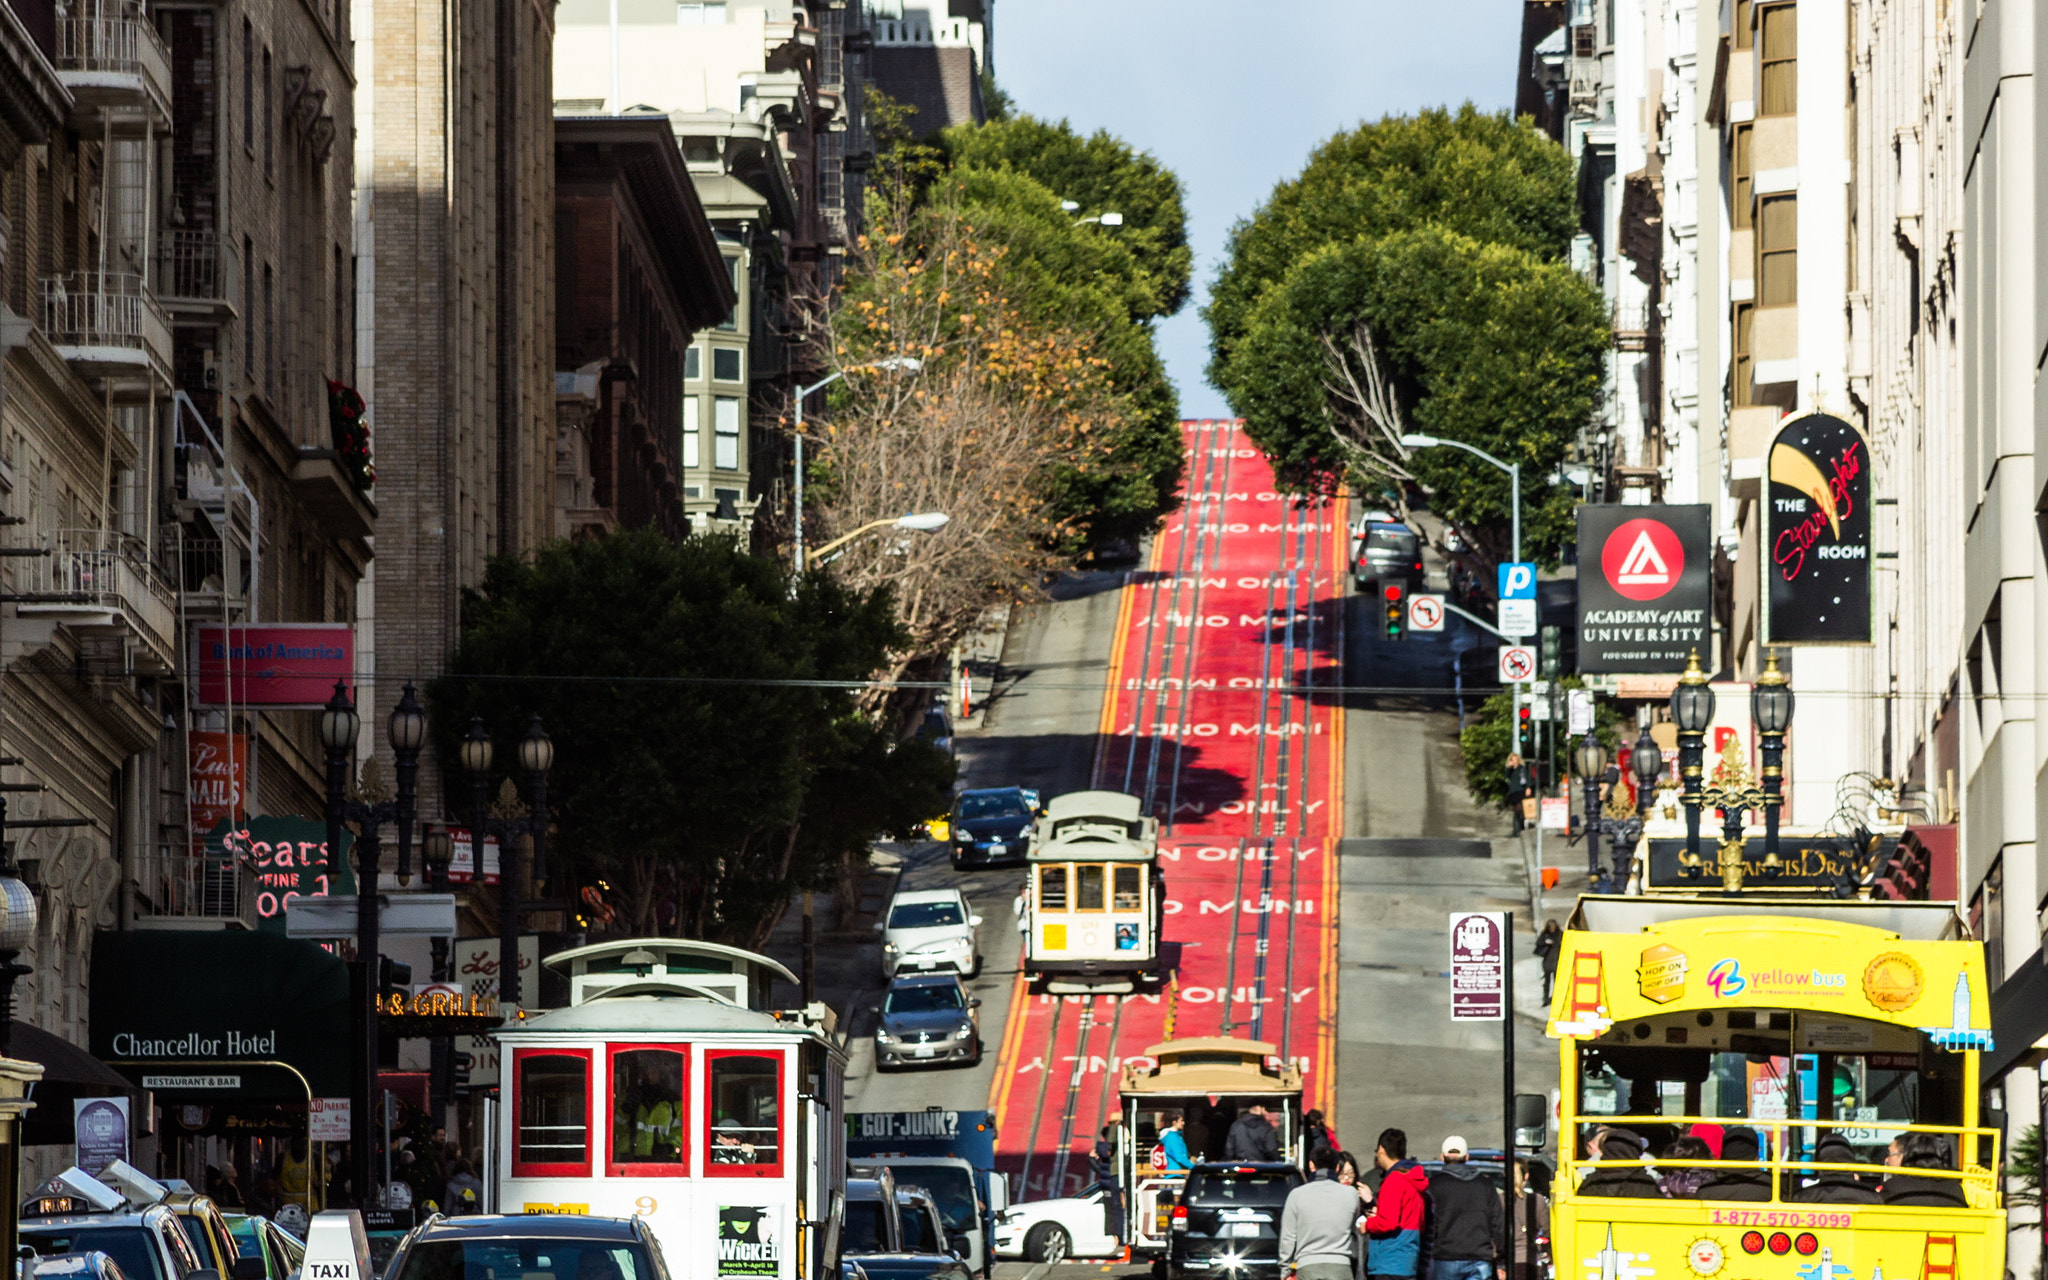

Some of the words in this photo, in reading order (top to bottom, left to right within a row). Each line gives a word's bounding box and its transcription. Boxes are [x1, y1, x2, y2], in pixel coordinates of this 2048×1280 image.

[1775, 499, 1806, 512] THE
[1818, 546, 1866, 559] ROOM
[1584, 609, 1659, 624] ACADEMY
[1659, 610, 1674, 626] of
[1672, 609, 1704, 623] ART
[1584, 627, 1704, 642] UNIVERSITY
[257, 643, 274, 659] of
[276, 643, 343, 659] America
[186, 779, 240, 806] NAILS
[1220, 800, 1324, 814] ONLY
[1197, 847, 1317, 861] ONLY
[1200, 900, 1313, 914] MUNI
[1645, 966, 1666, 976] HOP
[1668, 962, 1681, 971] ON
[1750, 970, 1809, 987] yellow
[1813, 969, 1846, 986] bus
[1181, 986, 1314, 1003] ONLY
[389, 991, 405, 1016] &
[413, 991, 484, 1017] GRILL
[112, 1033, 221, 1057] Chancellor
[227, 1029, 276, 1056] Hotel
[147, 1077, 206, 1086] RESTAURANT
[208, 1077, 215, 1086] &
[217, 1077, 236, 1086] BAR
[635, 1195, 658, 1216] 9
[1712, 1209, 1851, 1228] 1-877-570-3099
[311, 1263, 350, 1279] TAXI
